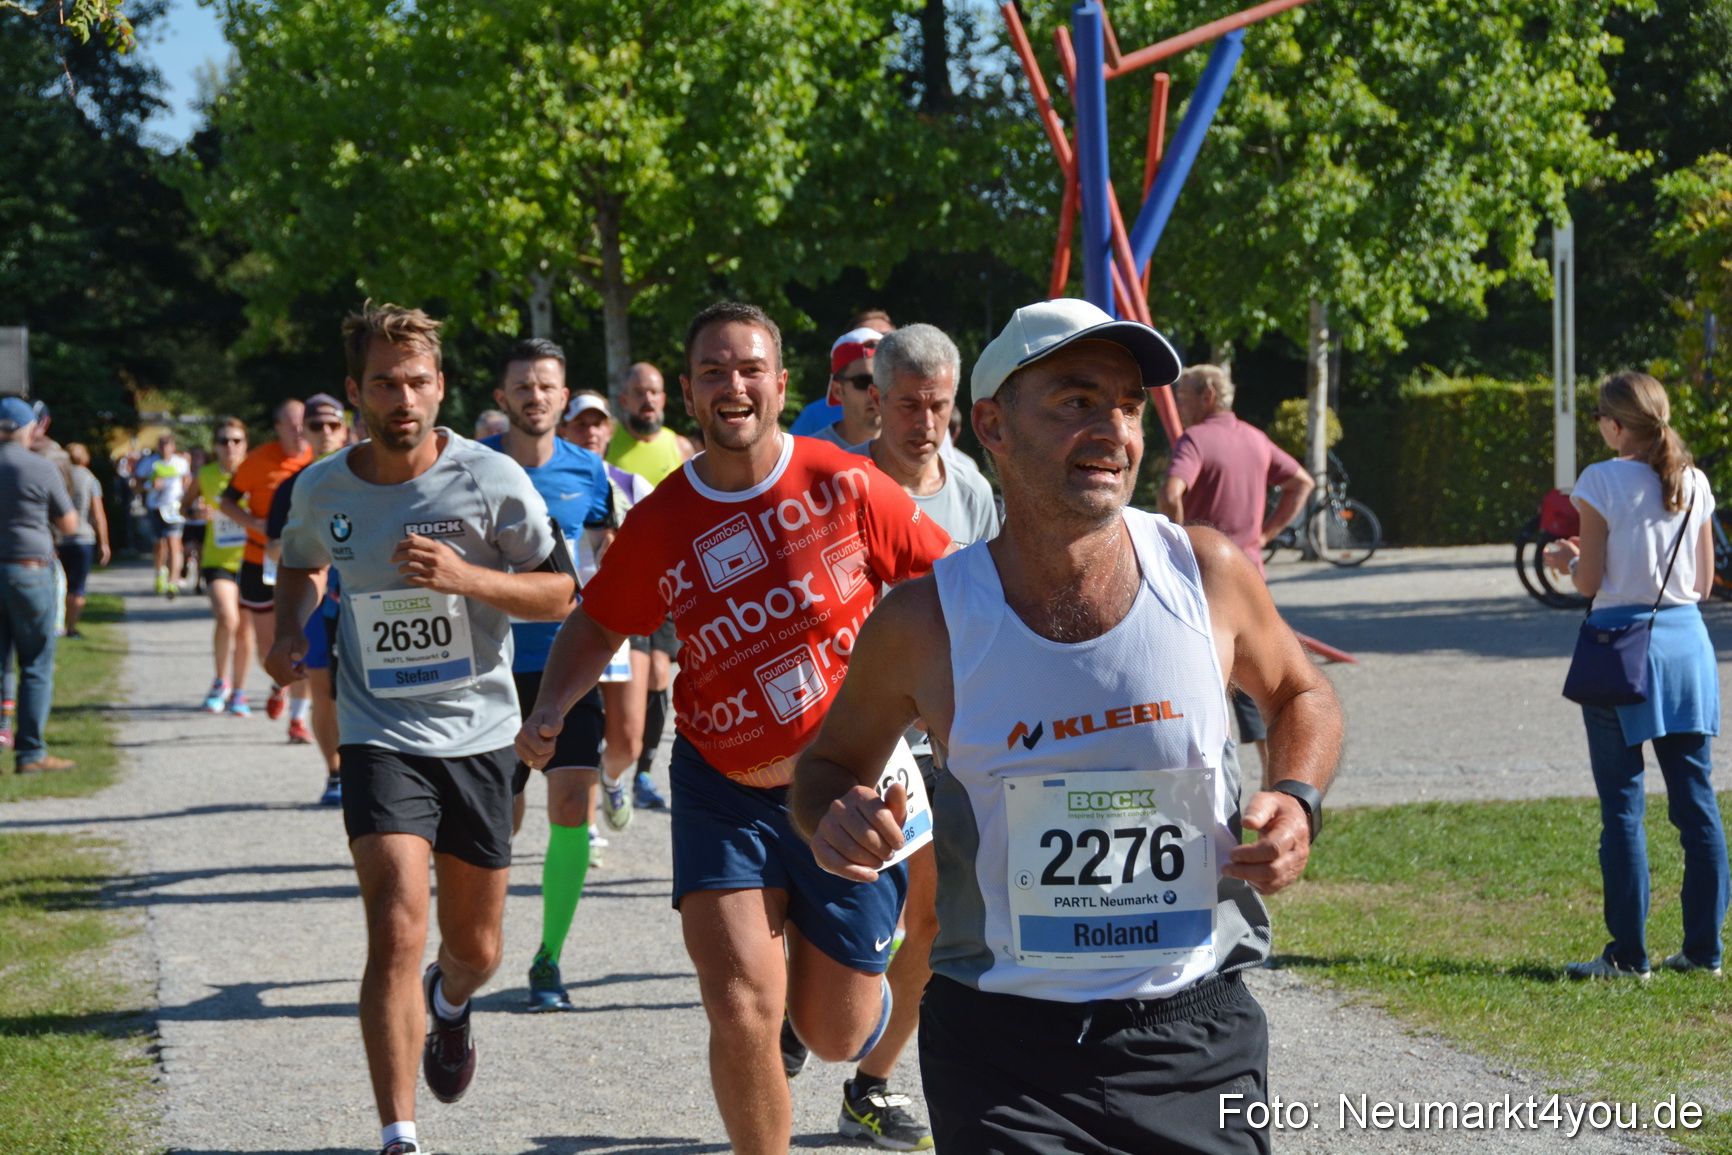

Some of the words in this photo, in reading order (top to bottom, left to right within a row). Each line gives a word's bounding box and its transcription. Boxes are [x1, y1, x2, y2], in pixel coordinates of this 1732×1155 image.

[758, 467, 870, 543] raum
[404, 520, 462, 536] BOCK
[698, 519, 747, 553] raumbox
[776, 520, 838, 560] schenken
[846, 503, 867, 523] wo
[826, 537, 868, 565] raumbo
[658, 559, 693, 607] ox
[383, 597, 431, 612] BOCK
[373, 616, 452, 652] 2630
[686, 571, 826, 671] umbox
[718, 638, 770, 672] wohnen
[778, 607, 832, 641] outdoor
[406, 653, 439, 663] Neumarkt
[760, 650, 809, 684] raumbox
[395, 668, 439, 685] Stefan
[683, 688, 758, 735] box
[1052, 700, 1184, 740] KLEBL
[719, 724, 765, 751] outdoor
[1068, 789, 1156, 812] BOCK
[1068, 811, 1095, 820] inspired
[1096, 811, 1105, 819] by
[1040, 825, 1185, 885] 2276
[1020, 875, 1028, 886] C
[1054, 896, 1097, 908] PARTL
[1100, 893, 1159, 907] Neumarkt
[1074, 919, 1159, 947] Roland
